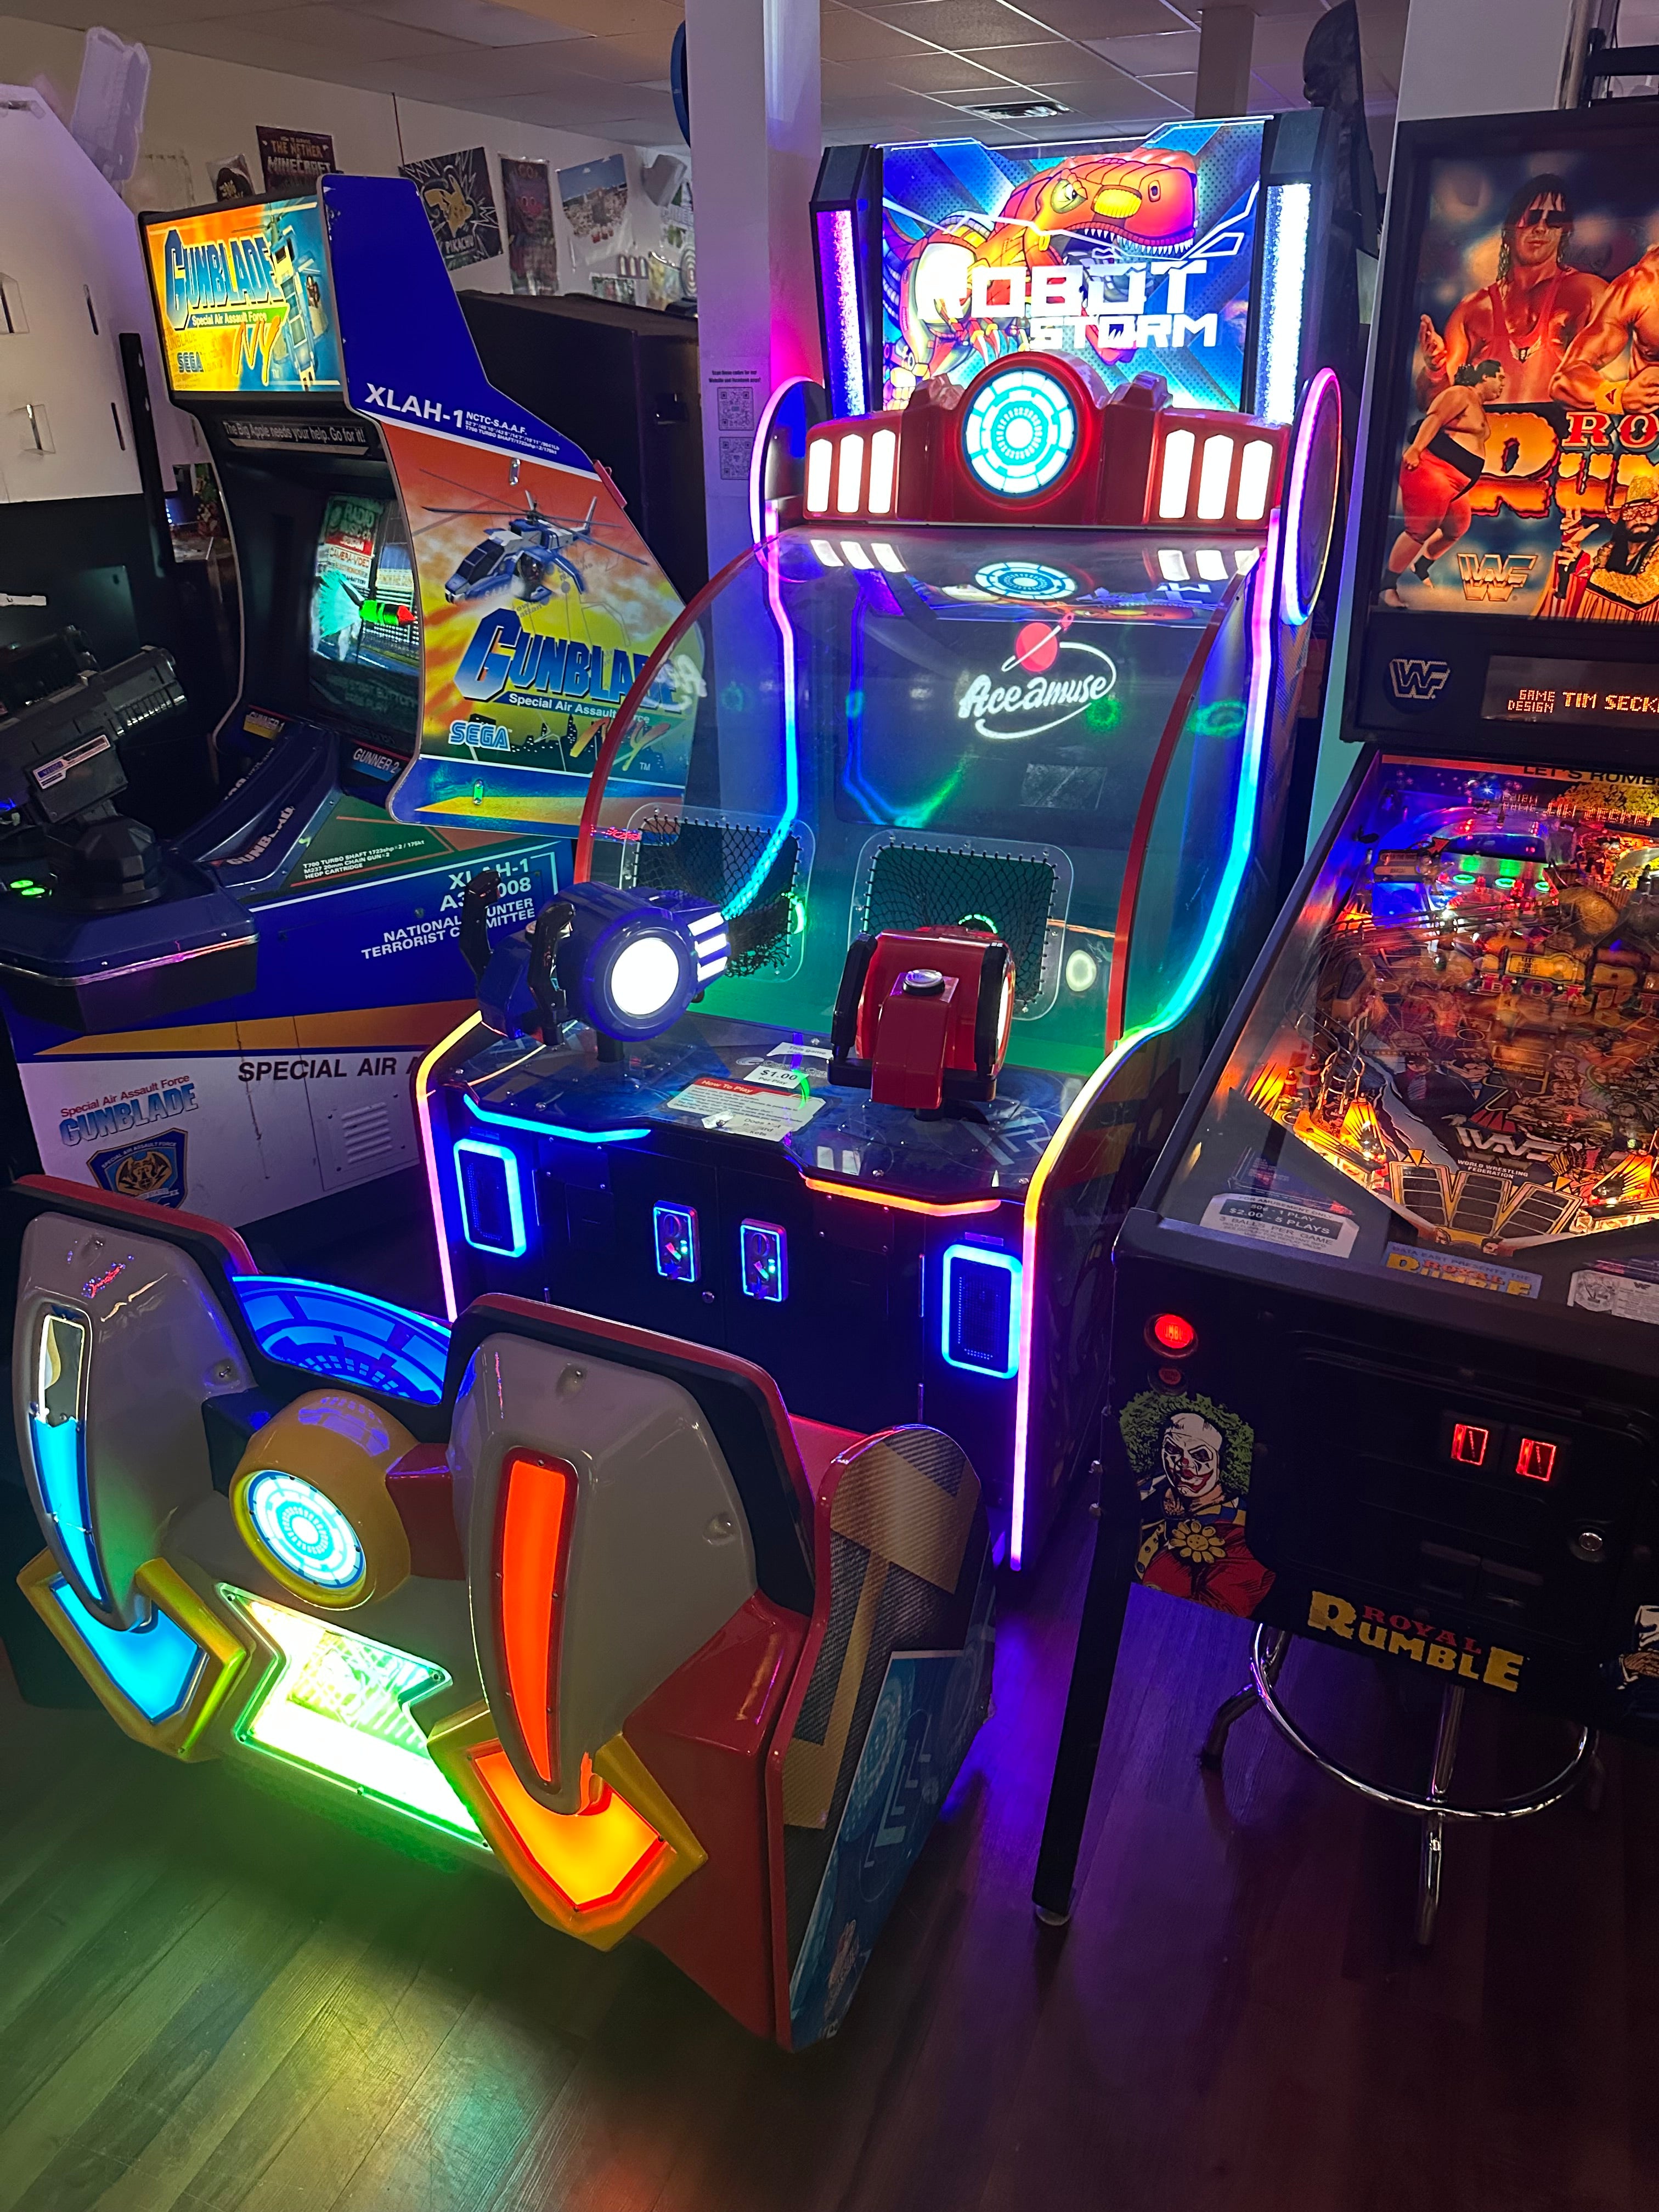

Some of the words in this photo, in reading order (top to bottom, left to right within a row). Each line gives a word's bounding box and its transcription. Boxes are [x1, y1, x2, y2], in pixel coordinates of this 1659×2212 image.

[268, 156, 331, 174] MINECRAFT
[165, 229, 285, 331] GUNBLADE
[192, 314, 213, 328] Special
[214, 314, 223, 324] Air
[224, 312, 248, 324] Assault
[248, 311, 268, 322] Force
[1031, 313, 1218, 350] STORM
[177, 351, 204, 373] SEGA
[232, 315, 282, 386] NY
[365, 382, 463, 428] XLAH-1
[223, 421, 238, 435] The
[237, 422, 250, 438] Big
[250, 423, 270, 439] Apple
[270, 425, 292, 438] needs
[292, 428, 309, 442] your
[309, 427, 330, 443] help.
[329, 427, 342, 439] Go
[342, 427, 355, 442] for
[355, 428, 366, 443] it!
[466, 411, 528, 436] NCTC-S.A.A.F.
[344, 502, 375, 527] RADIO
[509, 693, 552, 710] Special
[555, 699, 572, 712] Air
[574, 704, 617, 719] Assault
[1508, 699, 1554, 714] DESIGN
[1519, 690, 1555, 702] GAME
[1562, 692, 1597, 709] TIM
[1604, 694, 1659, 714] SECK
[449, 721, 510, 751] SEGA
[353, 748, 392, 771] GUNNER
[390, 761, 400, 774] 2
[639, 761, 651, 771] TM
[303, 866, 322, 874] M237
[324, 861, 344, 871] 20mm
[345, 857, 366, 866] CHAIN
[321, 856, 344, 865] TURBO
[345, 851, 367, 860] SHAFT
[304, 871, 324, 880] HEDP
[325, 862, 363, 876] CARTRIDGE
[383, 915, 462, 943] NATIONAL
[361, 930, 445, 960] TERRORIST
[238, 1058, 347, 1082] SPECIAL
[357, 1057, 397, 1076] AIR
[760, 1070, 798, 1080] $1.00
[61, 1099, 100, 1119] Special
[103, 1094, 117, 1108] Air
[121, 1083, 160, 1104] Assault
[161, 1075, 190, 1093] Force
[702, 1080, 723, 1088] How
[735, 1085, 754, 1094] Play
[59, 1083, 199, 1148] GUNBLADE
[101, 1153, 122, 1168] SPECIAL
[133, 1142, 159, 1151] ASSAULT
[1457, 1159, 1485, 1169] WORLD
[1485, 1164, 1529, 1178] WRESTLING
[1467, 1166, 1514, 1180] FEDERATION
[1257, 1197, 1311, 1213] AMUSEMENT
[1287, 1211, 1316, 1222] PLAY
[1229, 1207, 1264, 1218] $2.00
[1286, 1218, 1331, 1235] PLAYS
[1232, 1218, 1265, 1228] BALLS
[1271, 1224, 1294, 1235] PER
[1300, 1231, 1333, 1245] GAME
[1392, 1246, 1418, 1255] DATA
[1421, 1251, 1446, 1261] EAST
[1451, 1259, 1507, 1274] PRESENTS
[1511, 1272, 1531, 1280] THE
[1424, 1259, 1506, 1285] ROYAL
[1307, 1590, 1524, 1692] RUMBLE
[1362, 1604, 1482, 1655] ROYAL
